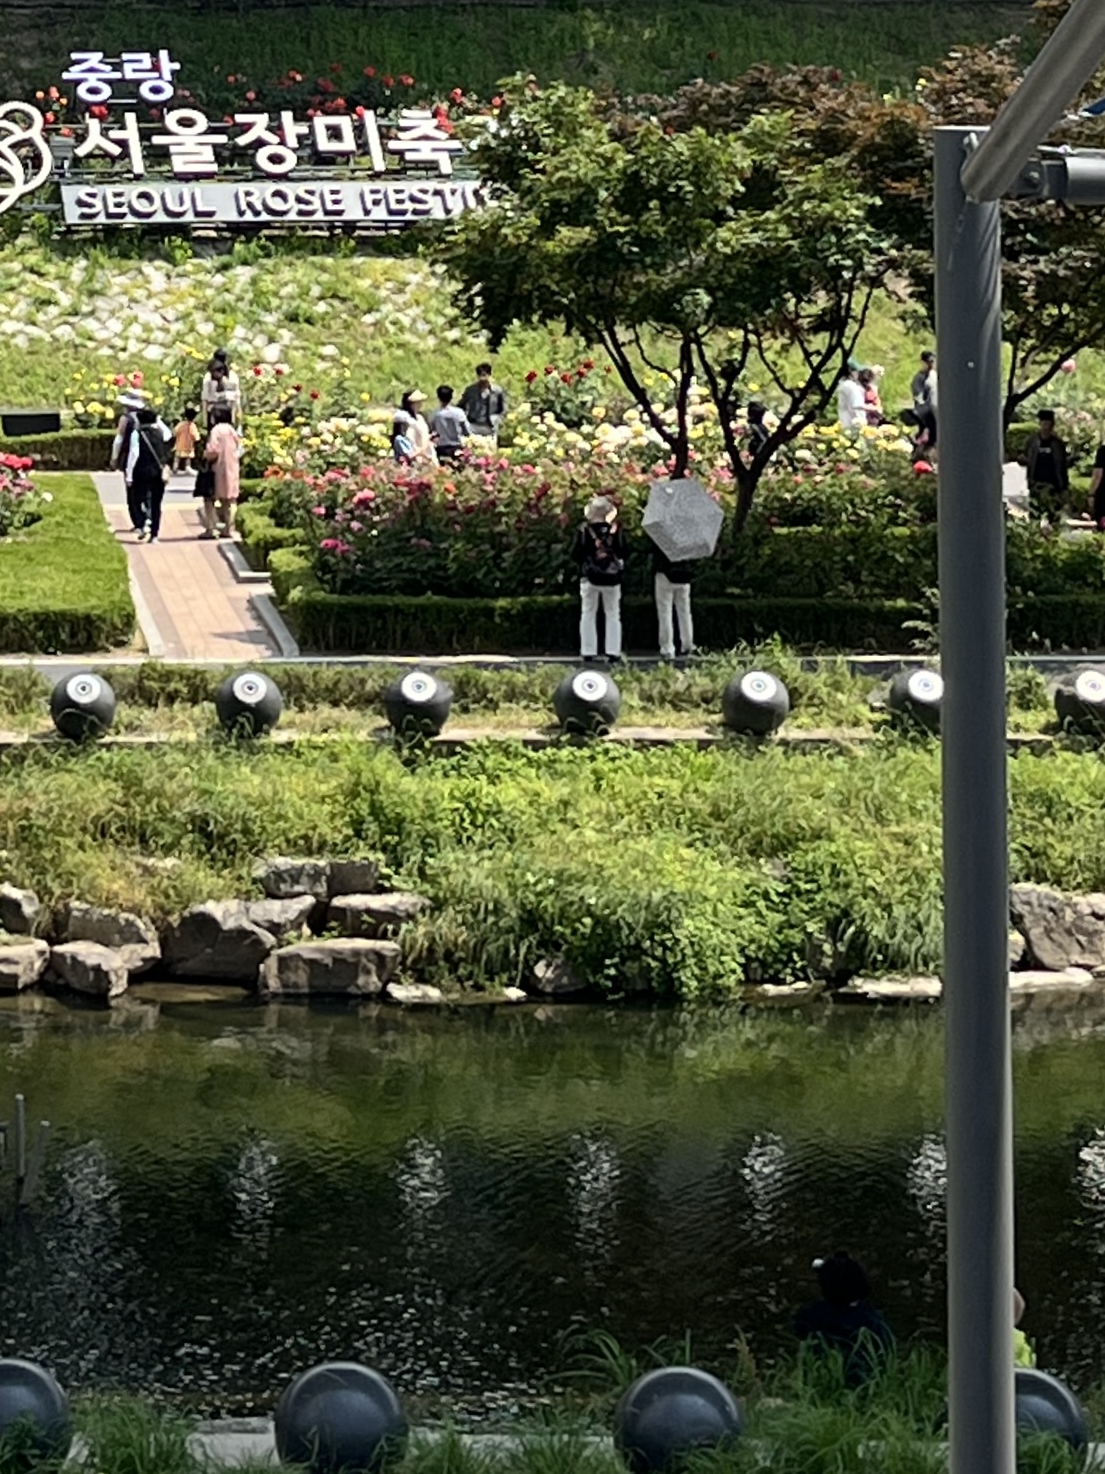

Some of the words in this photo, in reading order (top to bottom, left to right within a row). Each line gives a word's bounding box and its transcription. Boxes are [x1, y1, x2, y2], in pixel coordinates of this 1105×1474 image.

[61, 49, 181, 102] 중랑
[74, 107, 490, 175] 서울장미축
[76, 186, 216, 218] SEOUL
[236, 185, 346, 217] ROSE
[360, 182, 492, 217] FESTI
